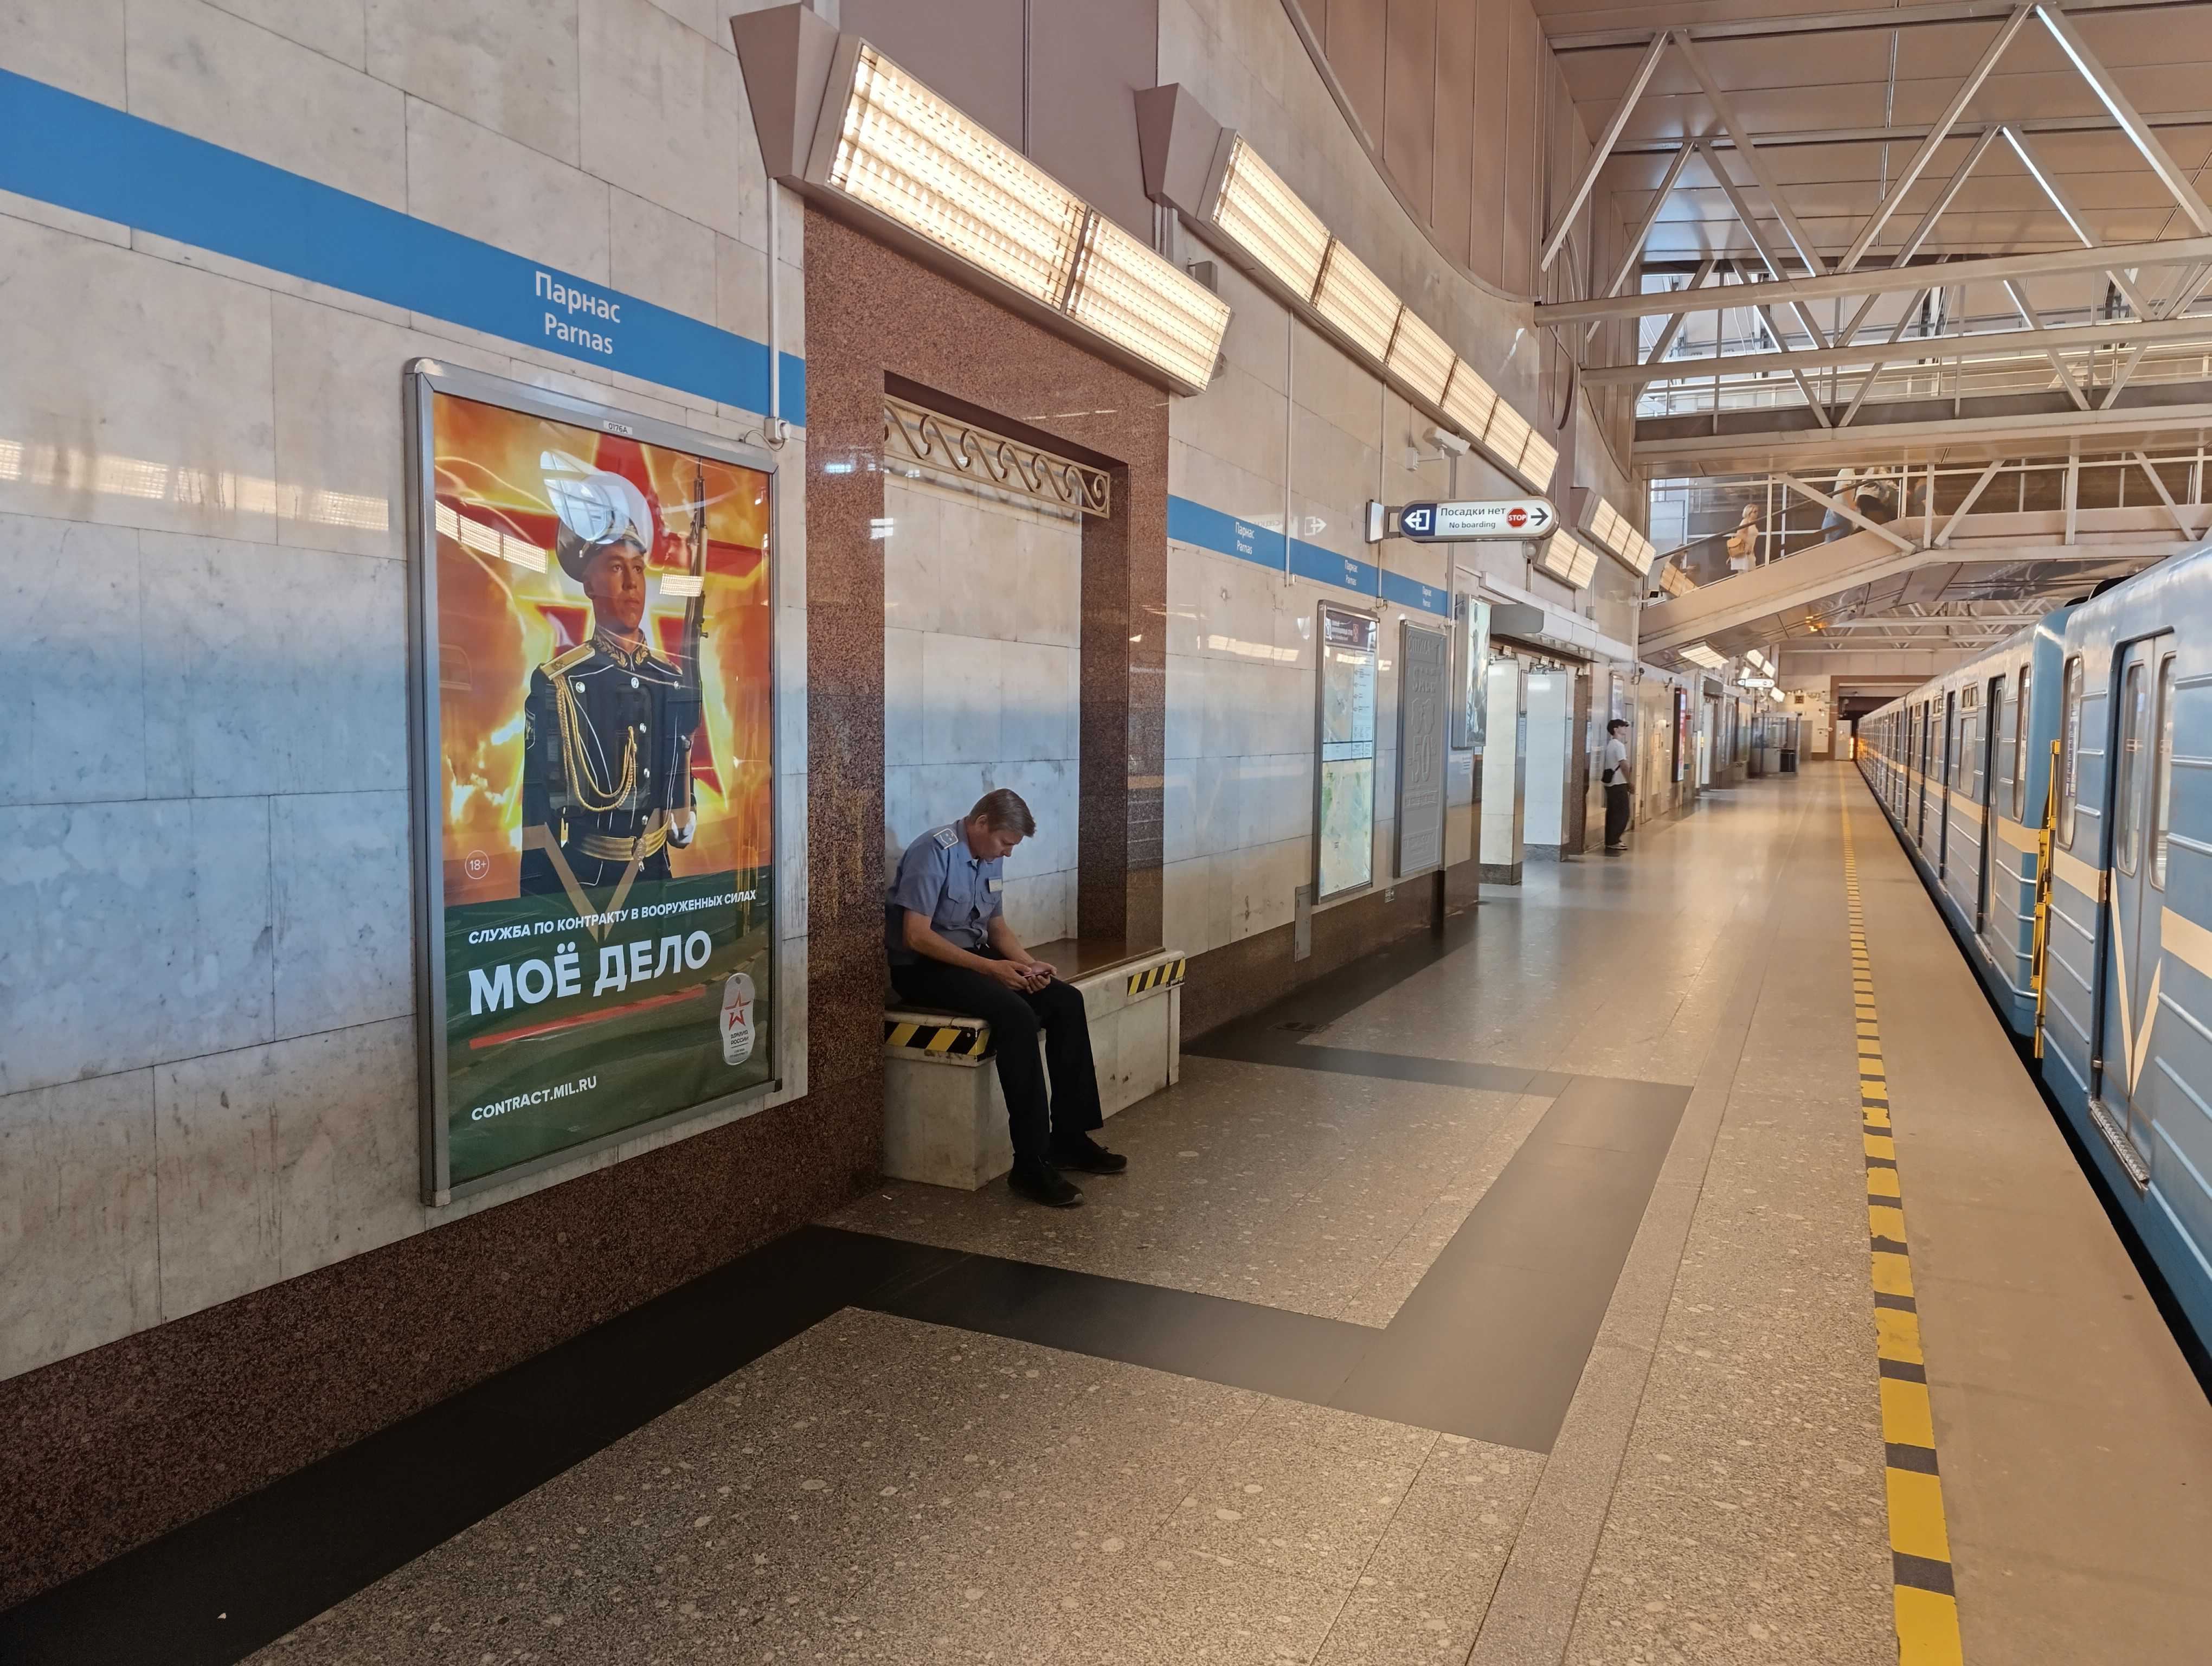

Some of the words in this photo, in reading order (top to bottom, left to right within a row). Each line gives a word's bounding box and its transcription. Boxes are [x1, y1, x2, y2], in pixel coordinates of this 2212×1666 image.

[535, 271, 621, 323] Парнас
[545, 312, 613, 354] Parnas
[1441, 508, 1485, 516] Посадки
[1236, 521, 1255, 539] Парнас
[1237, 540, 1253, 555] Parnas
[470, 860, 487, 871] 18+
[468, 924, 531, 944] СЛУЖБА
[534, 921, 554, 935] ПО
[557, 909, 628, 932] КОНТРАКТУ
[631, 908, 639, 920] В
[641, 895, 723, 918] ВООРУЖЕННЫХ
[724, 889, 756, 905] СИЛАХ
[468, 941, 582, 1016] МОЁ
[593, 930, 712, 997] ДЕЛО
[731, 1030, 748, 1039] АРМИЯ
[731, 1036, 749, 1046] РОССИИ
[471, 1076, 597, 1121] CONTRACT.MIL.RU
